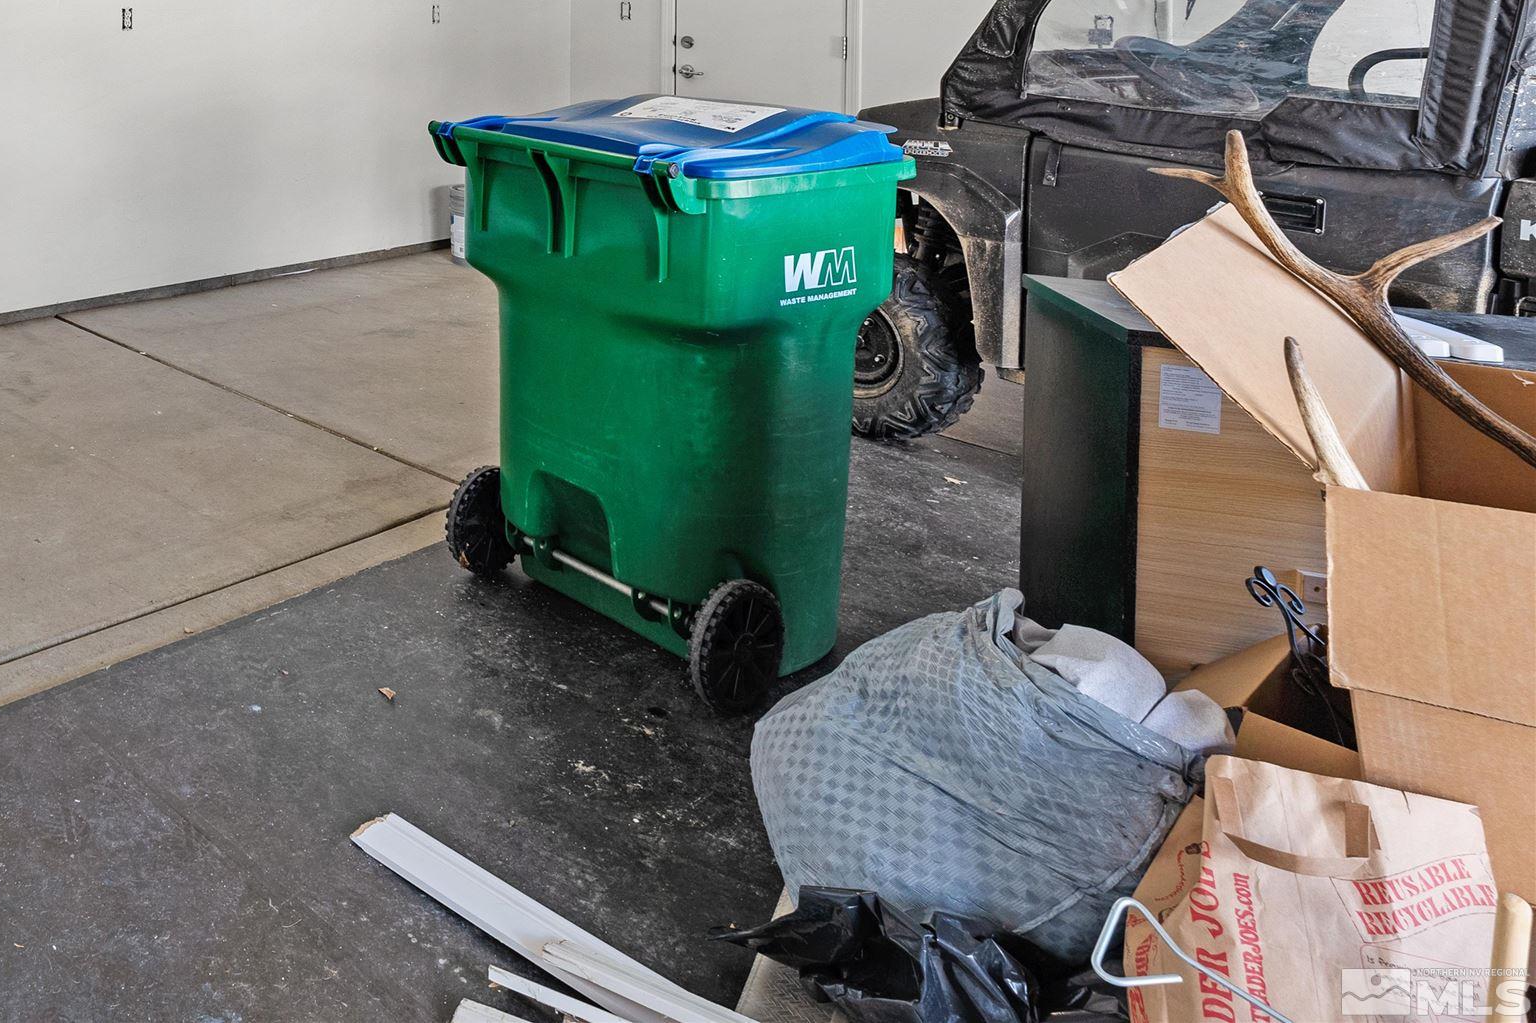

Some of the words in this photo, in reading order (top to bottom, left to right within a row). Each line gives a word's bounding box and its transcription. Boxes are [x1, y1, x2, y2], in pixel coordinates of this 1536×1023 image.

[784, 246, 857, 293] WM
[779, 295, 806, 307] WASTE
[807, 288, 857, 304] MANAGEMENT
[1352, 857, 1473, 907] REUSABLE
[1356, 884, 1498, 937] RECYCLABLE
